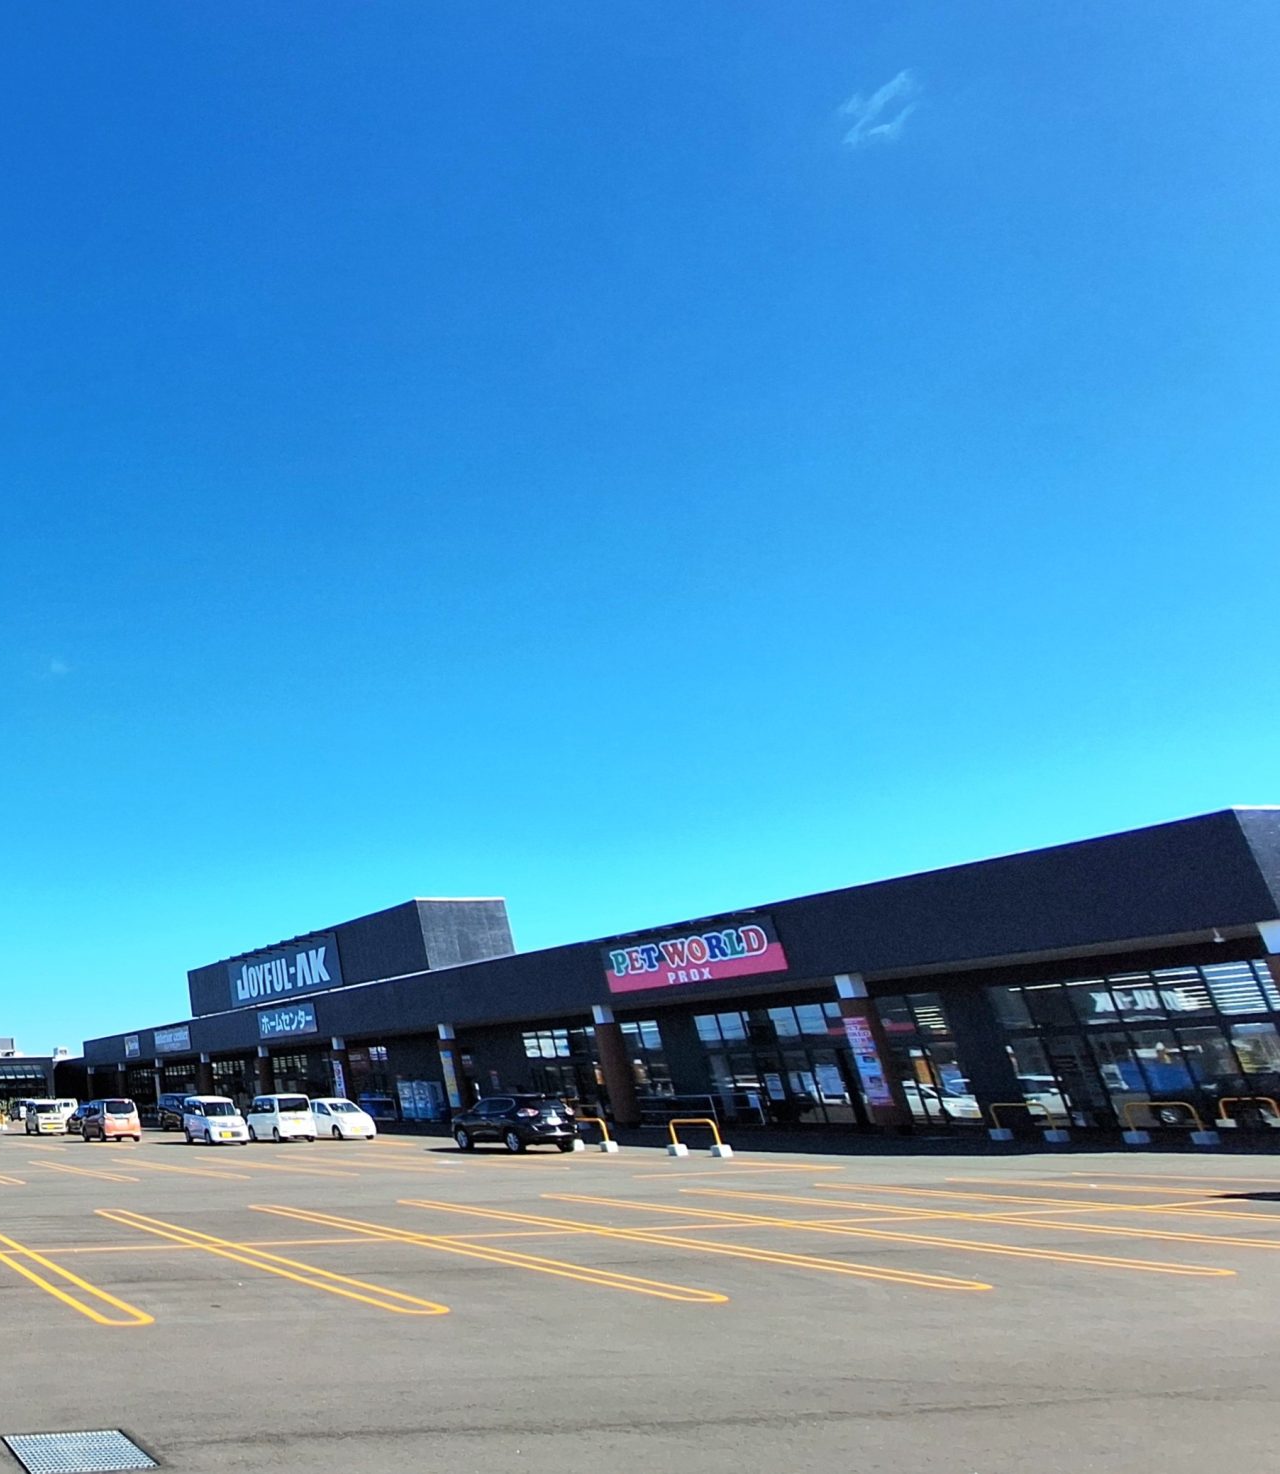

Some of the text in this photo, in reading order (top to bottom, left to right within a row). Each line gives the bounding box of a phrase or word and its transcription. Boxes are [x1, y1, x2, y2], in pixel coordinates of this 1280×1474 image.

[609, 925, 769, 977] PET WORLD
[236, 946, 331, 1001] JOYFUL-AK
[668, 966, 713, 985] PROX
[261, 1009, 313, 1034] ホームセンター
